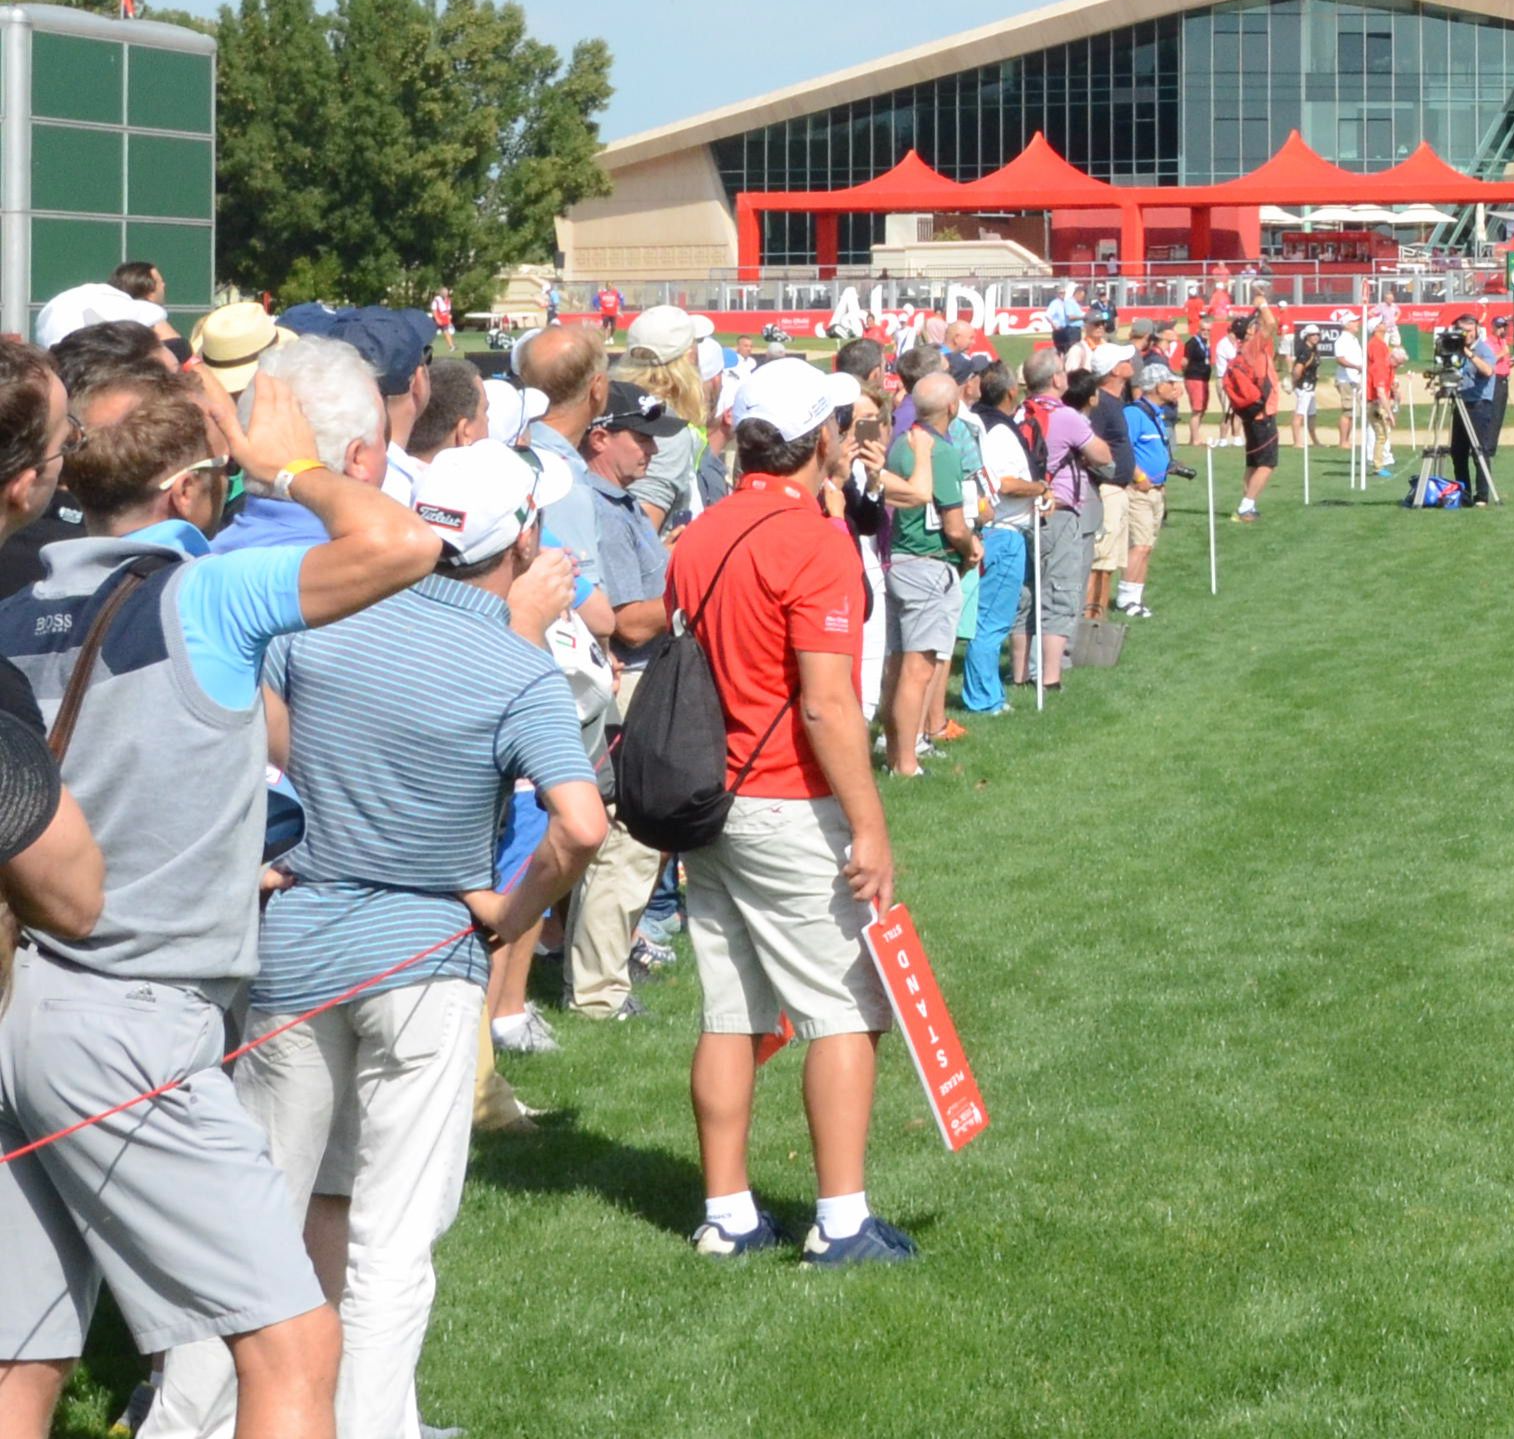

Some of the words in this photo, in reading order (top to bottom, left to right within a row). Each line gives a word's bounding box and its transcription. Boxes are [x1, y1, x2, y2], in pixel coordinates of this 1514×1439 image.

[36, 613, 73, 631] BOSS
[882, 923, 903, 943] STILL
[896, 949, 948, 1069] STAND
[938, 1069, 965, 1096] PLEASE
